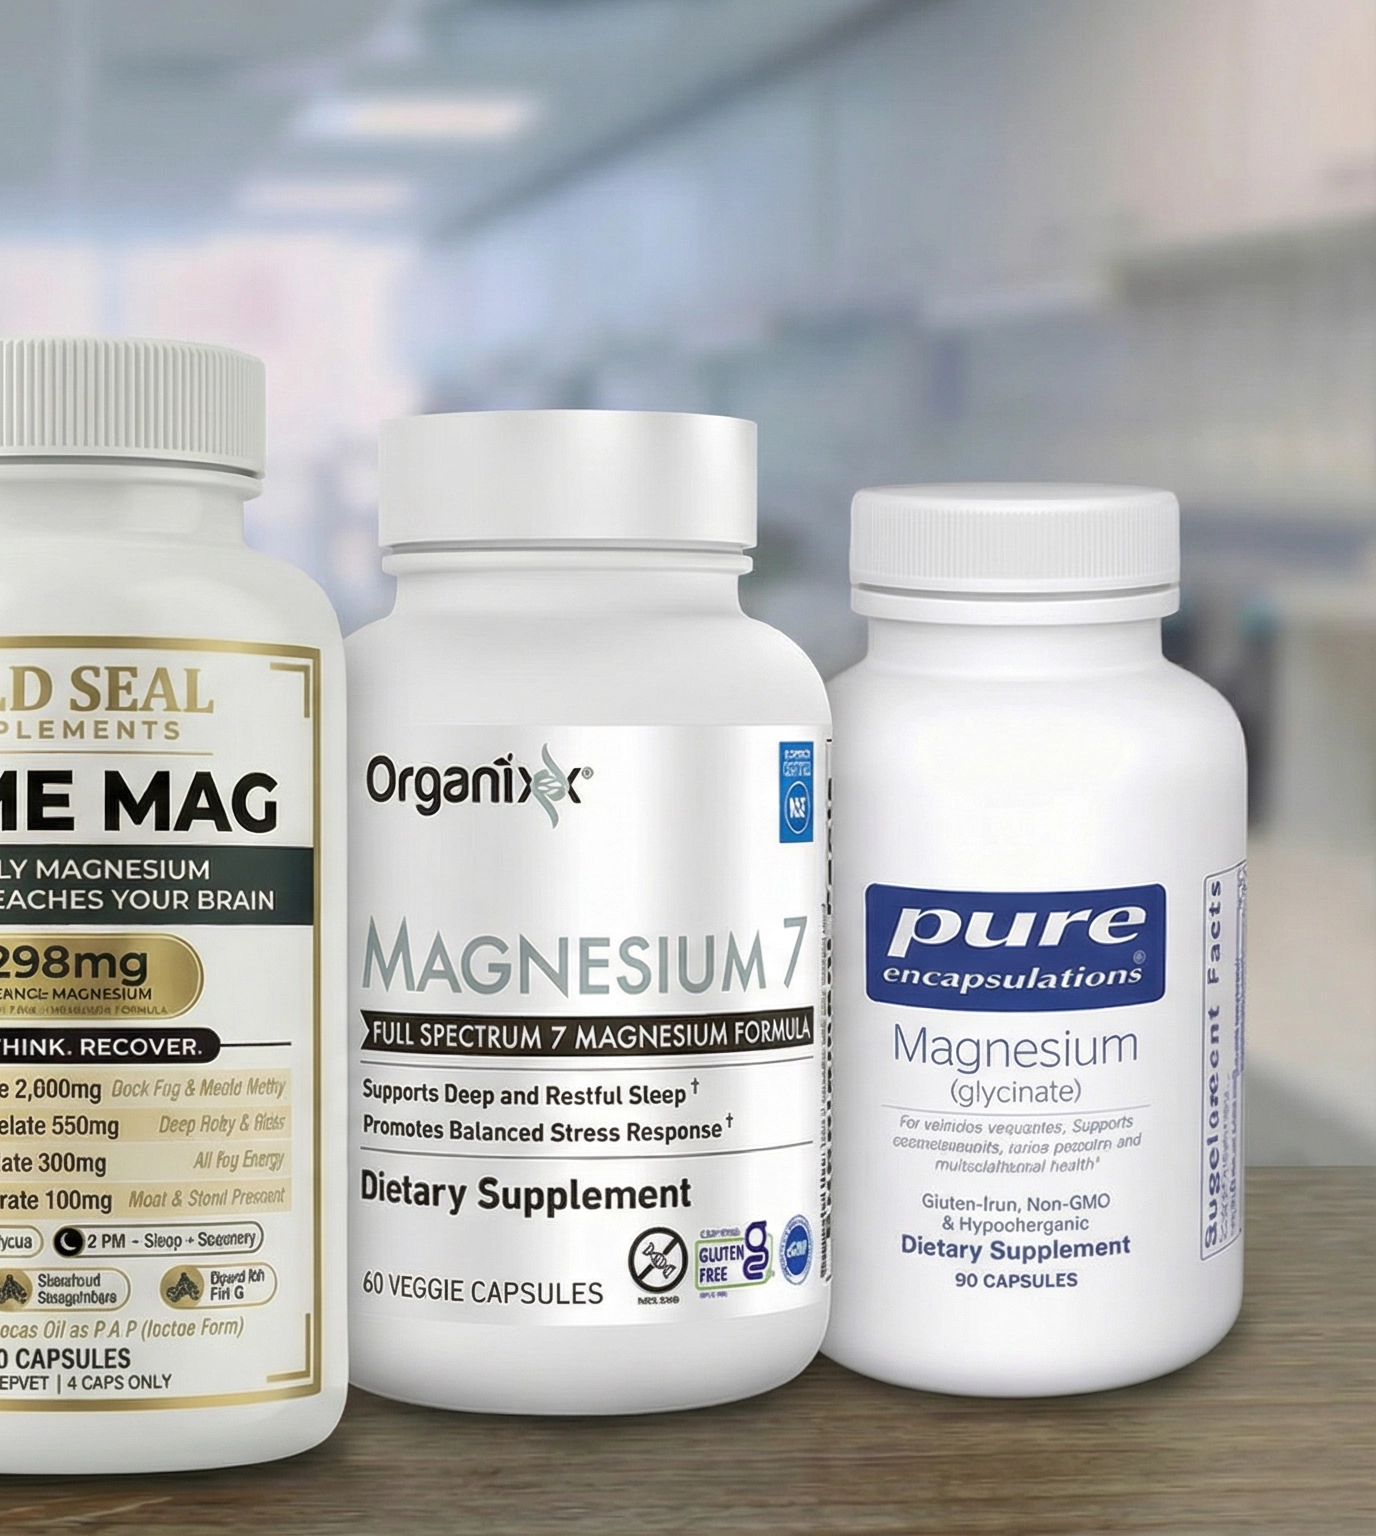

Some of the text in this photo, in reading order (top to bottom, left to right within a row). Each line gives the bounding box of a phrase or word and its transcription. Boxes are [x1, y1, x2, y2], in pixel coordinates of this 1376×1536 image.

[69, 666, 215, 714] SEAL
[103, 770, 278, 834] MAG
[35, 859, 210, 880] MAGNESIUM
[111, 889, 189, 911] YOUR
[197, 889, 275, 911] BRAIN
[887, 904, 1147, 958] pure
[362, 915, 808, 998] MAGNESIUM 7
[882, 965, 1143, 994] encapsulations
[53, 987, 152, 1001] MAGNESIUM
[373, 1015, 811, 1050] FULL SPECTRUM 7 MAGNESIUM FORMULA
[81, 1037, 203, 1056] RECOVER.
[893, 1023, 1139, 1075] Magnesium
[184, 1079, 195, 1097] &
[362, 1078, 439, 1105] Supports
[444, 1082, 495, 1109] Deep
[500, 1083, 539, 1106] and
[546, 1083, 622, 1106] Restful
[950, 1077, 1082, 1108] (glycinate)
[52, 1115, 119, 1140] 550mg
[159, 1115, 196, 1136] Deep
[239, 1114, 250, 1131] &
[363, 1114, 444, 1140] Promotes
[450, 1119, 544, 1142] Balanced
[550, 1122, 620, 1143] Stress
[1072, 1116, 1133, 1134] Supports
[1117, 1132, 1142, 1148] and
[38, 1152, 107, 1177] 300mg
[45, 1190, 112, 1214] 100mg
[171, 1190, 182, 1207] &
[361, 1170, 692, 1218] Dietary Supplement
[1027, 1193, 1111, 1212] Non-GMO
[942, 1215, 955, 1231] &
[87, 1234, 97, 1249] 2
[102, 1234, 125, 1249] PM
[901, 1234, 1131, 1264] Dietary Supplement
[699, 1244, 744, 1264] GLUTEN
[699, 1267, 728, 1283] FREE
[955, 1272, 1078, 1288] 90 CAPSULES
[362, 1271, 604, 1305] 60 VEGGIE CAPSULES
[43, 1319, 66, 1339] Oil
[70, 1323, 89, 1338] as
[200, 1316, 245, 1338] Form)
[15, 1348, 131, 1369] CAPSULES
[67, 1375, 77, 1390] 4
[81, 1375, 124, 1391] CAPS
[128, 1373, 172, 1390] ONLY
